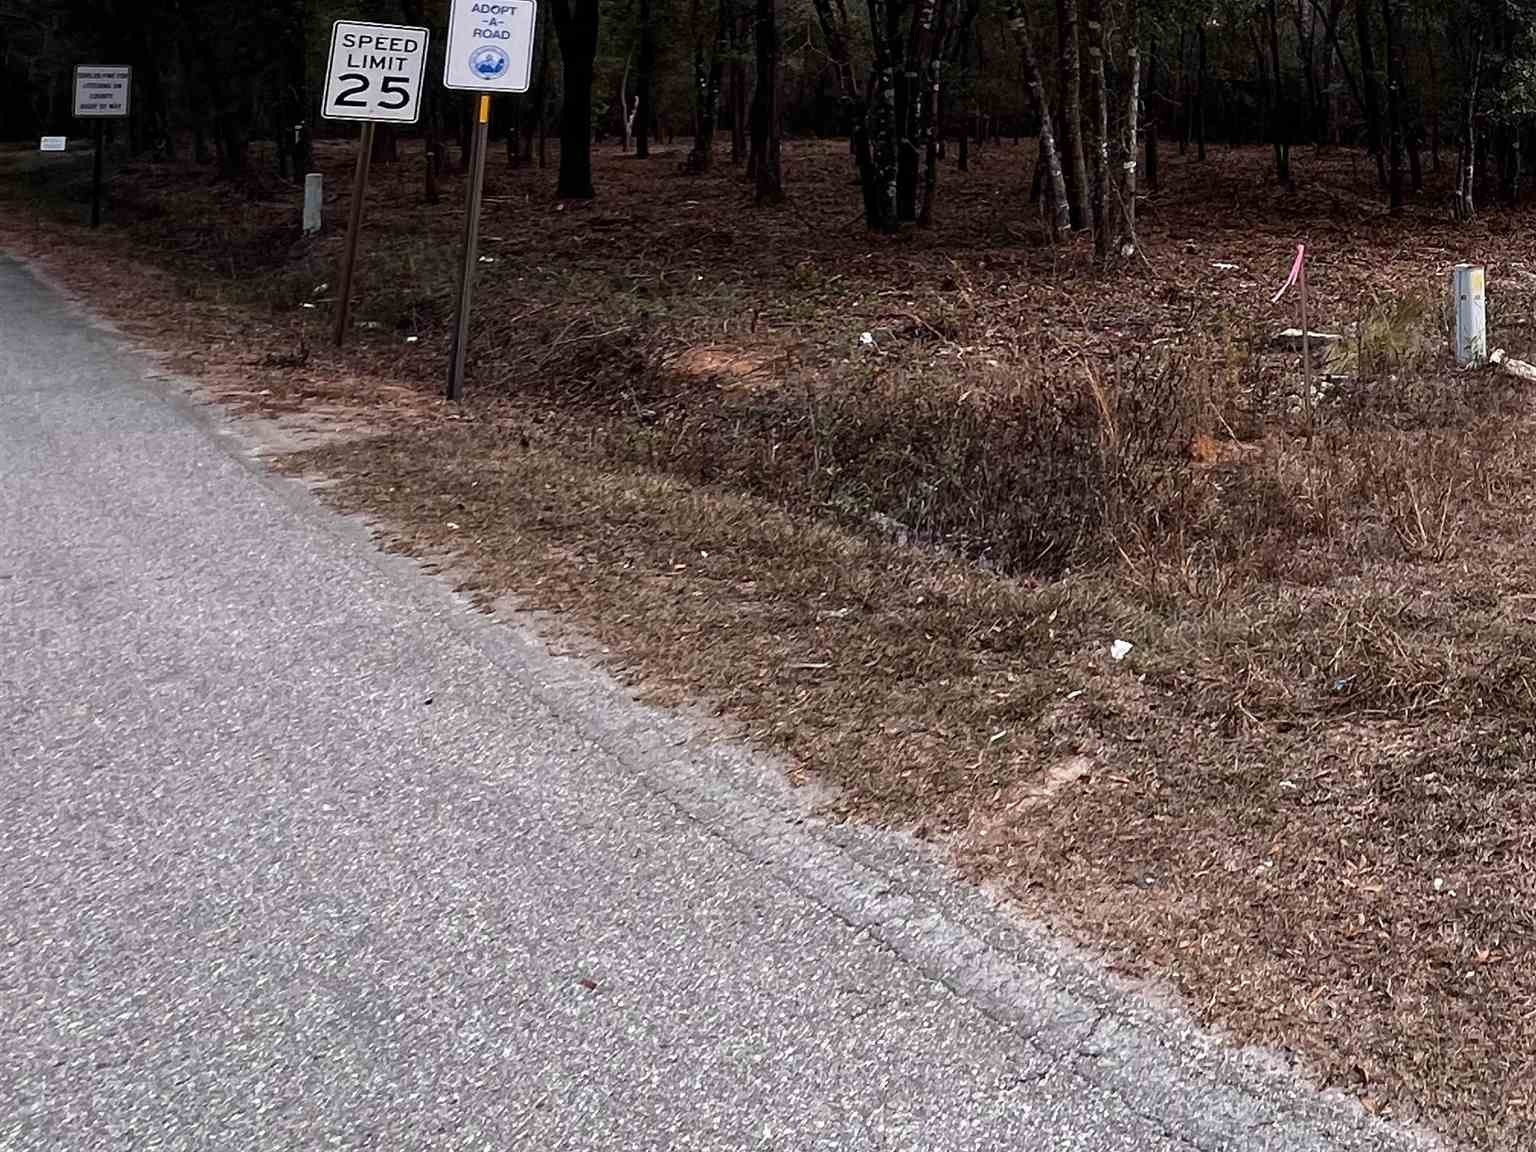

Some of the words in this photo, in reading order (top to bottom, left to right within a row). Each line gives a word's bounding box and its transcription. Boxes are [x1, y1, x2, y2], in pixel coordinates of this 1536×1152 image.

[471, 3, 518, 16] ADOPT
[472, 28, 511, 40] ROAD
[342, 33, 418, 53] SPEED
[347, 54, 408, 71] LIMIT
[334, 73, 411, 110] 25
